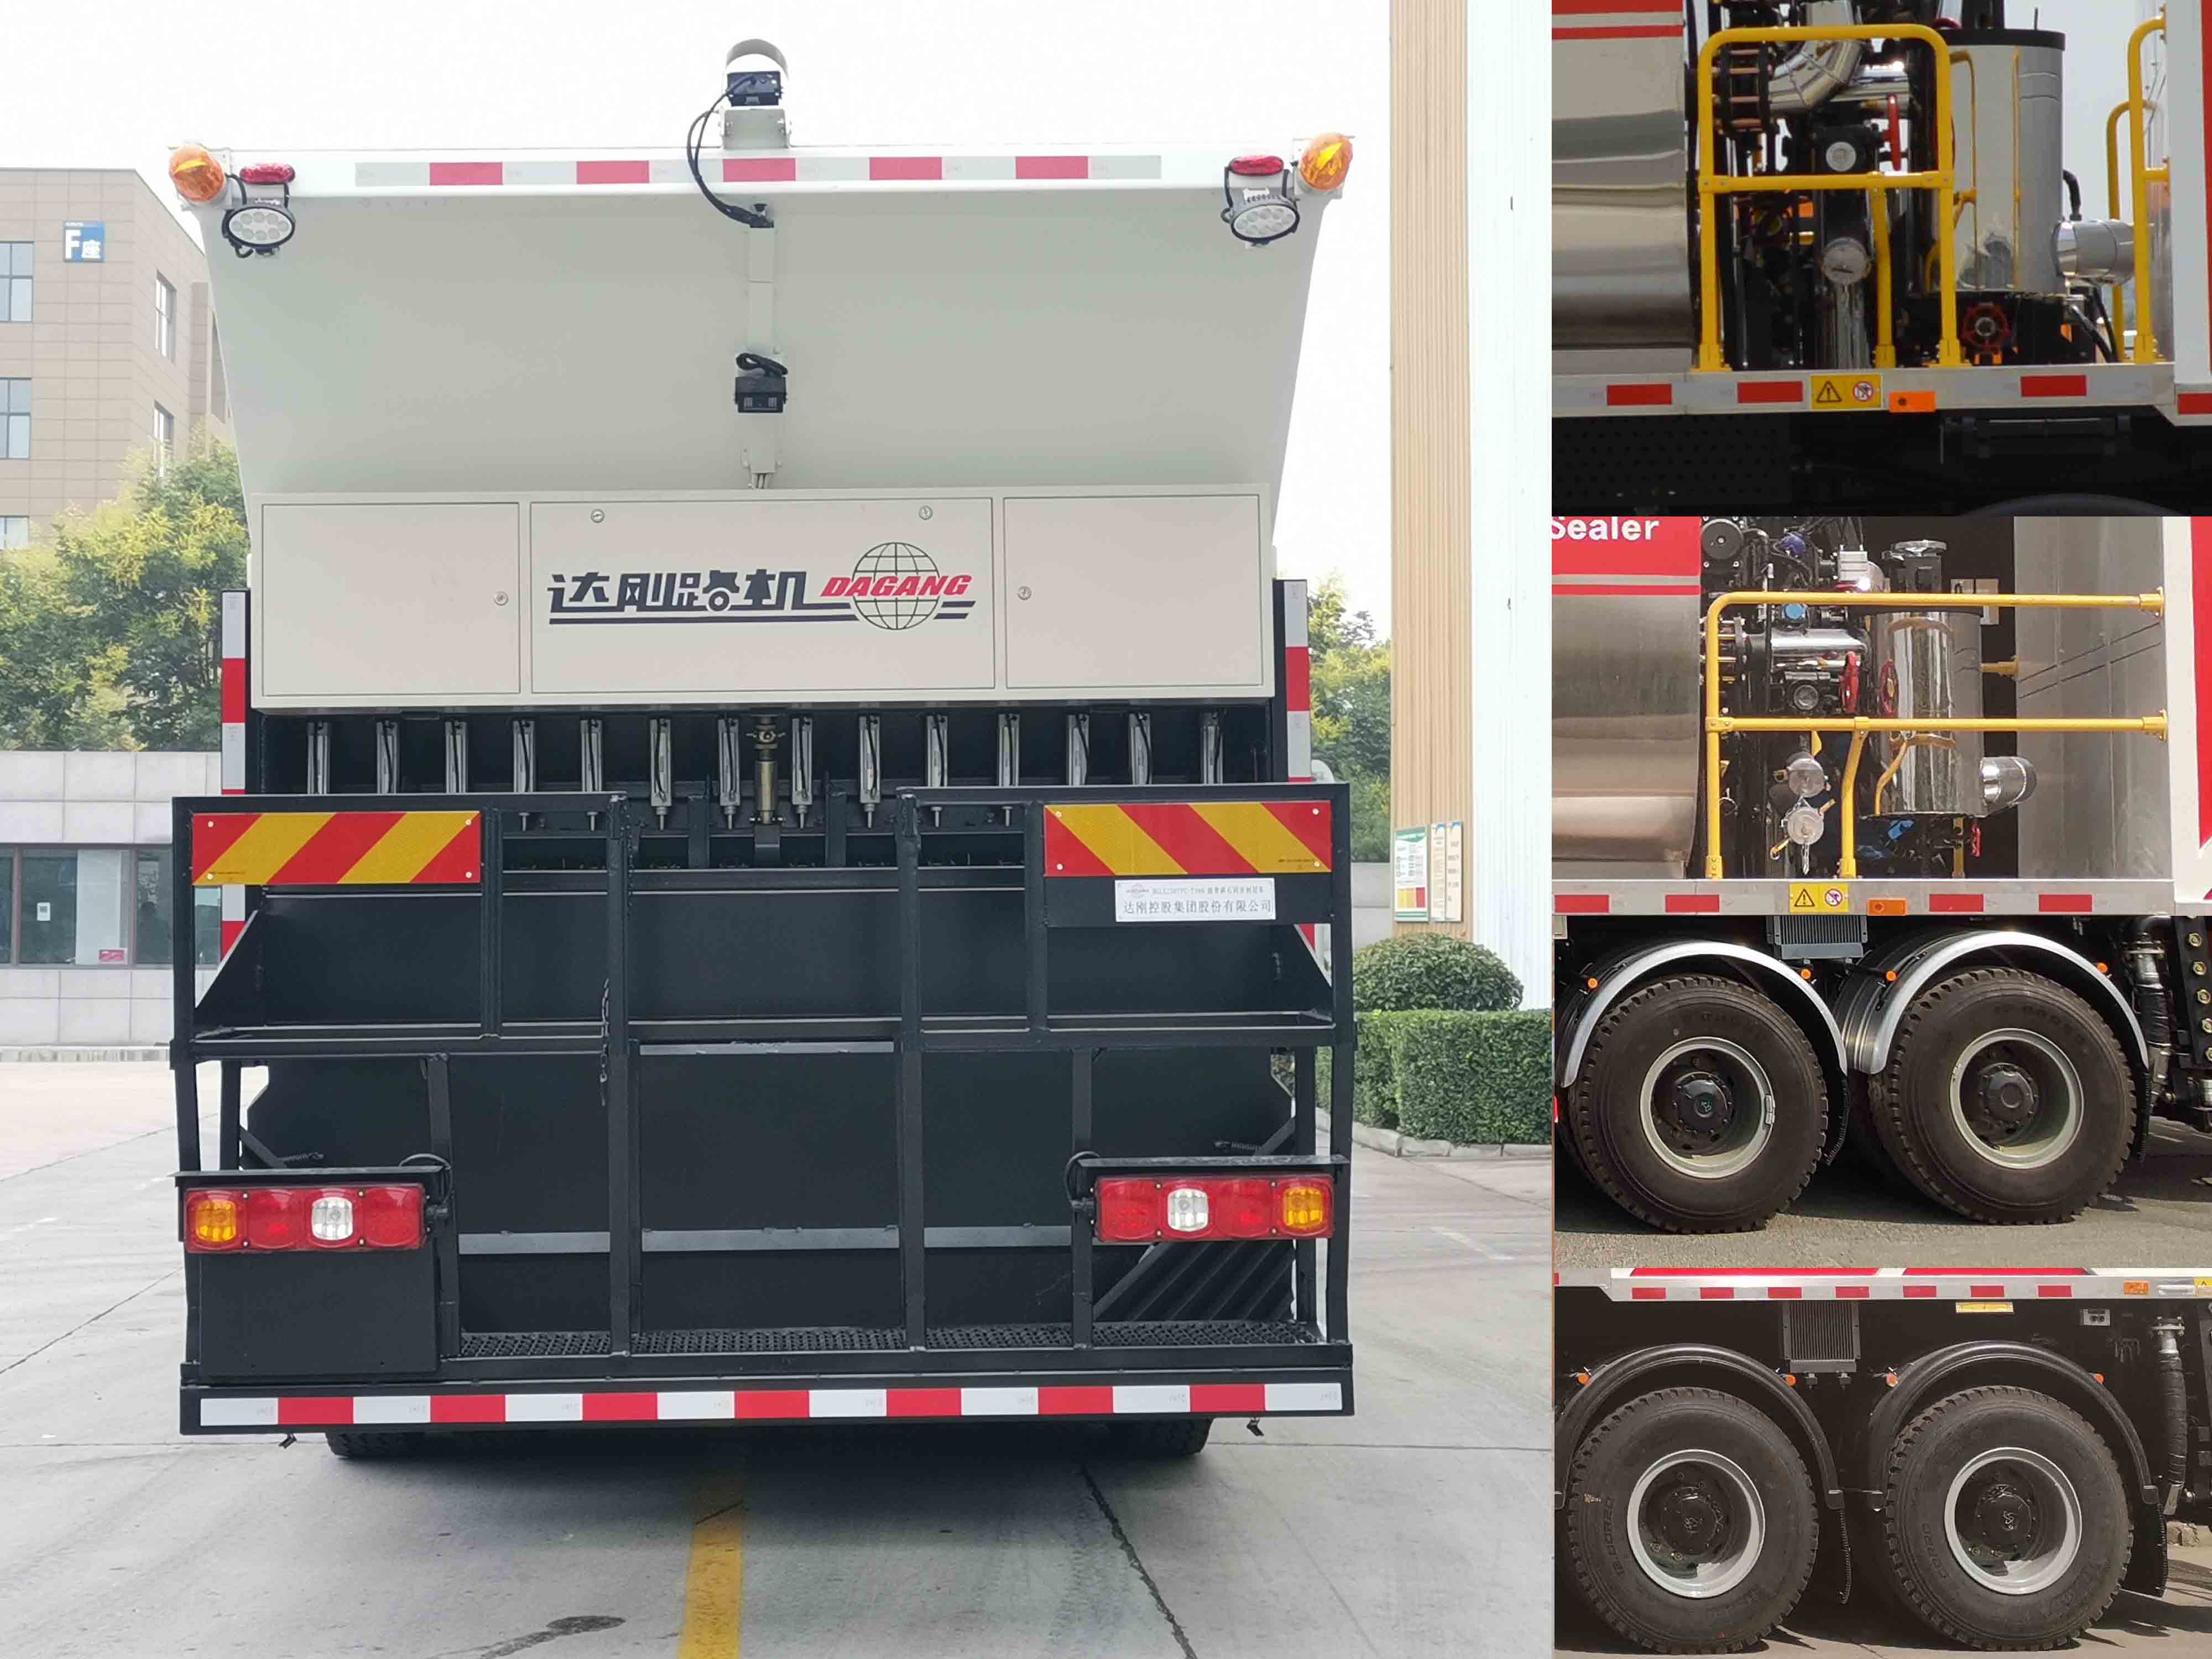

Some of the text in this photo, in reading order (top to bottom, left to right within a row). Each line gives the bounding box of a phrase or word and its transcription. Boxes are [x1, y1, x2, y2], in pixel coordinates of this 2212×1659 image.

[547, 569, 807, 612] 达刚路机
[819, 575, 972, 598] DAGANG
[1123, 899, 1271, 914] 达刚控股集团股份有限公司
